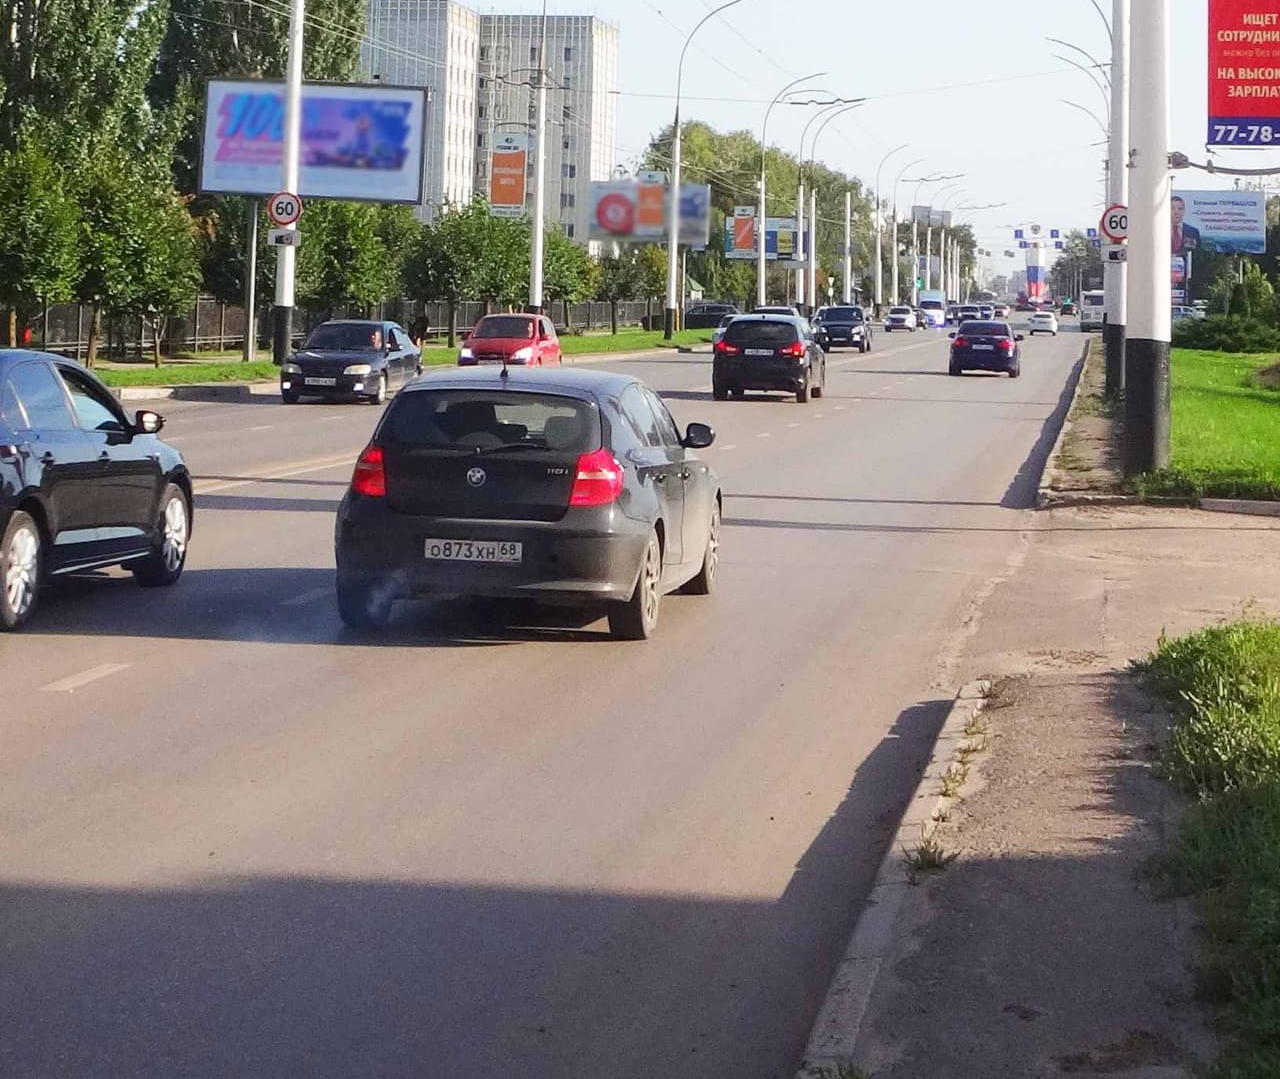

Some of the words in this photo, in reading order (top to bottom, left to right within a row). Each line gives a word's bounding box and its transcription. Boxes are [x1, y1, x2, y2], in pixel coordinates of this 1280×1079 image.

[1242, 13, 1279, 27] ИЩЕТ
[1217, 67, 1235, 80] НА
[275, 201, 294, 216] 60
[1108, 215, 1128, 230] 60
